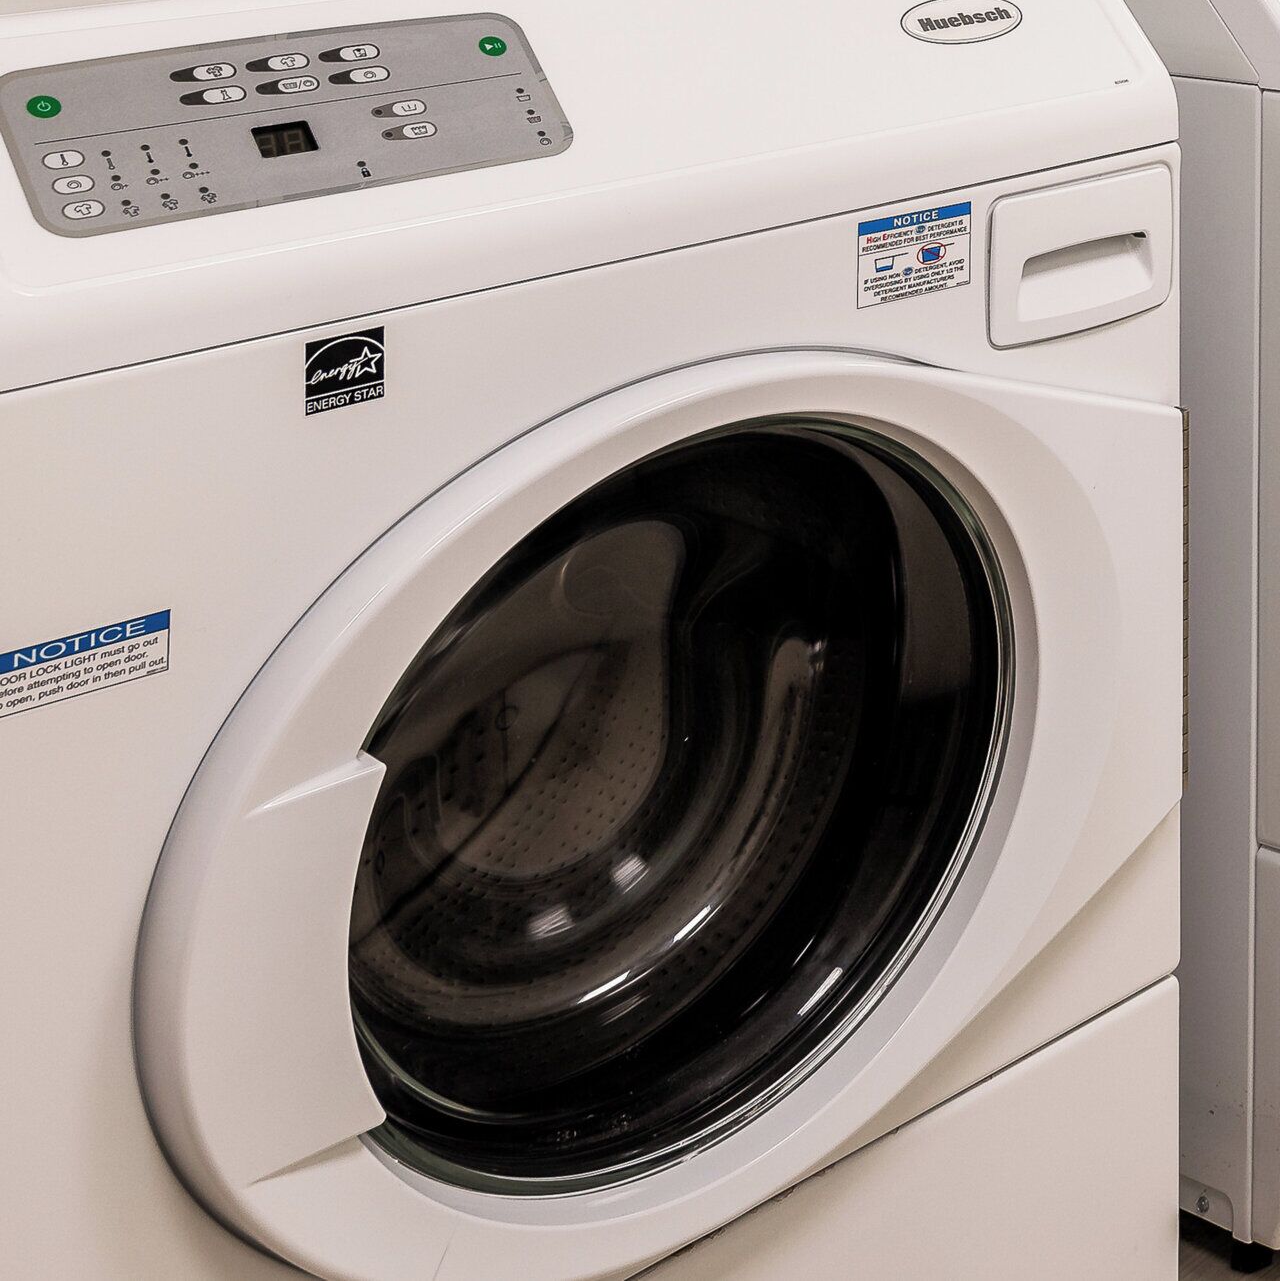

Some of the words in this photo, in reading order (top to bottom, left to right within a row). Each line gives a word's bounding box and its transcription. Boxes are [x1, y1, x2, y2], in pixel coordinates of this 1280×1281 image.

[917, 7, 1013, 32] Huebsch
[893, 210, 939, 227] NOTICE
[927, 220, 958, 232] DETERGENT
[861, 238, 903, 253] RECOMMENDED
[903, 236, 915, 245] FOR
[915, 233, 929, 242] BEST
[929, 225, 968, 239] PERFORMANCE
[870, 275, 888, 284] USING
[948, 258, 965, 267] AVOID
[912, 273, 930, 282] USING
[873, 285, 907, 297] DETERGENT
[880, 288, 923, 302] RECOMMENDED
[306, 392, 353, 414] ENERGY
[354, 385, 384, 403] STAR
[13, 618, 146, 668] NOTICE
[0, 672, 27, 687] OOR
[29, 663, 62, 679] LOCK
[64, 653, 98, 671] LIGHT
[100, 646, 125, 661] must
[127, 643, 141, 655] go
[142, 636, 159, 649] out
[0, 686, 24, 700] efore
[27, 669, 81, 692] attempting
[83, 666, 94, 677] to
[96, 659, 121, 675] open
[123, 650, 149, 665] door.
[6, 694, 36, 709] open,
[38, 686, 64, 701] push
[66, 677, 90, 691] door
[92, 675, 102, 685] in
[104, 669, 126, 681] then
[128, 663, 147, 678] pull
[148, 656, 167, 669] out.
